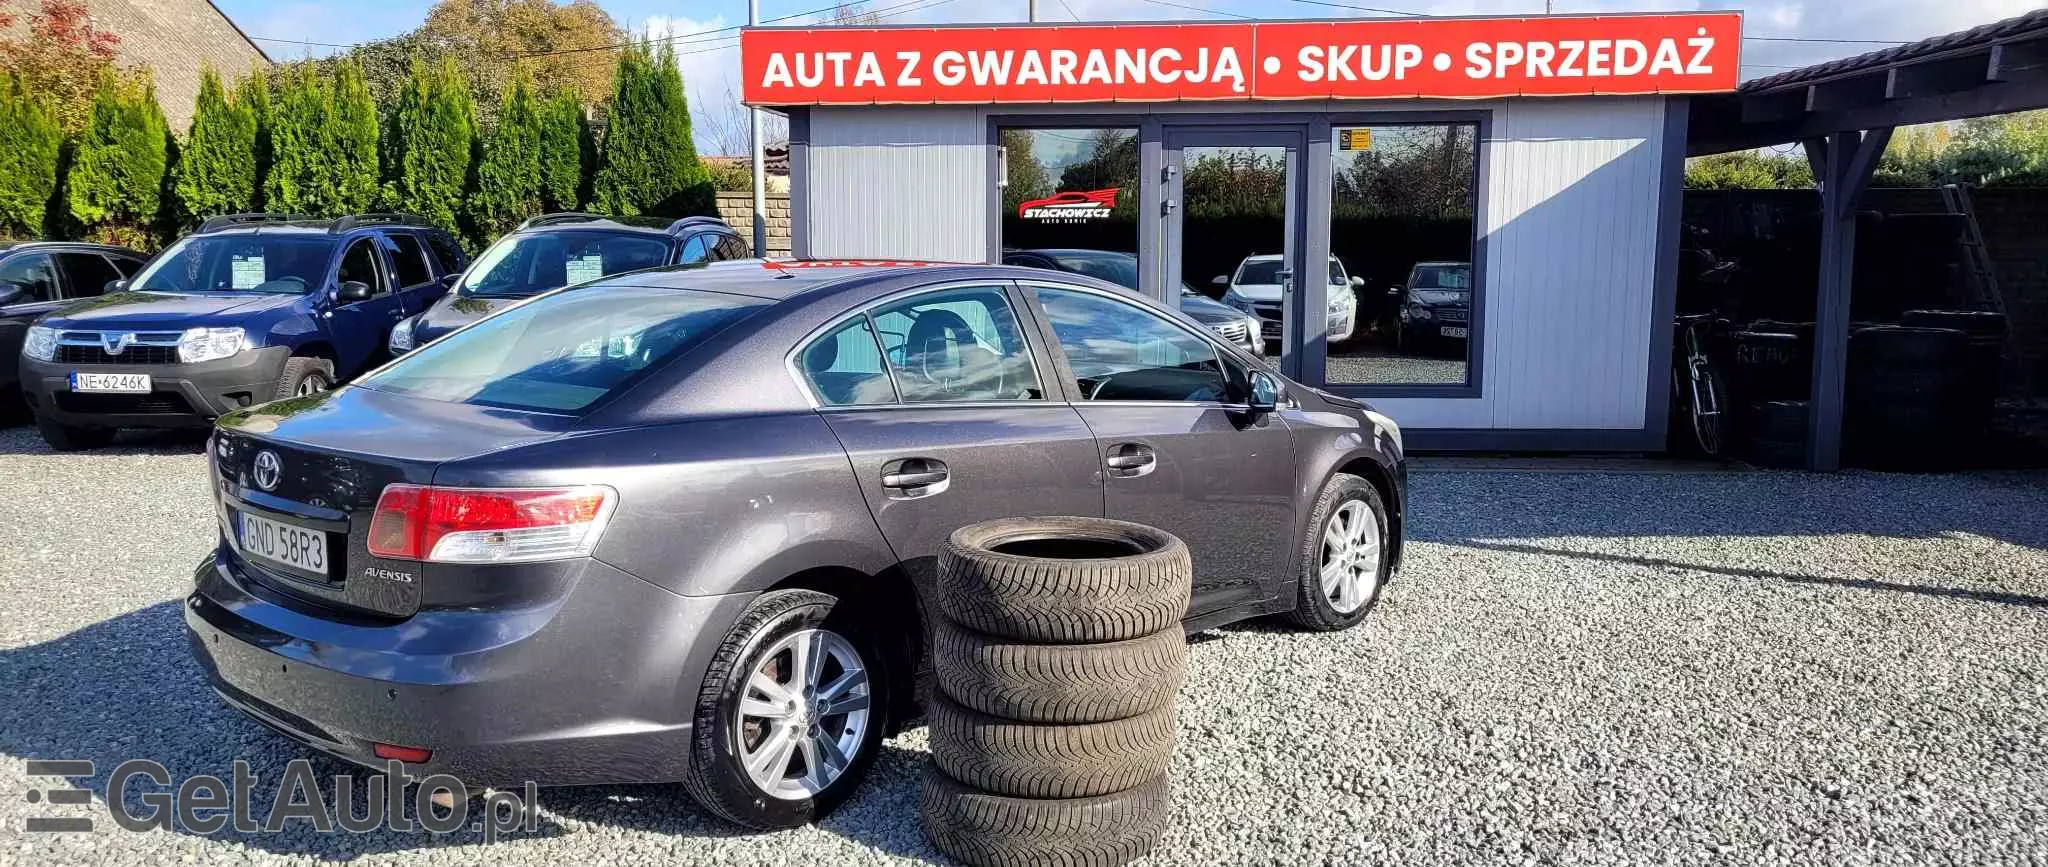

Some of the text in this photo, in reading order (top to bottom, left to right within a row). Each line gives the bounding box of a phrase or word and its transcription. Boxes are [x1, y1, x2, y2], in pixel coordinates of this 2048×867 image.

[763, 27, 1715, 93] AUTA Z GWARANCJĄ SKUP SPRZEDAŻ
[1023, 208, 1111, 218] STACHOWICZ
[80, 375, 146, 390] NE 6246K
[246, 518, 323, 569] GND 58R3
[364, 567, 413, 583] AVENSIS
